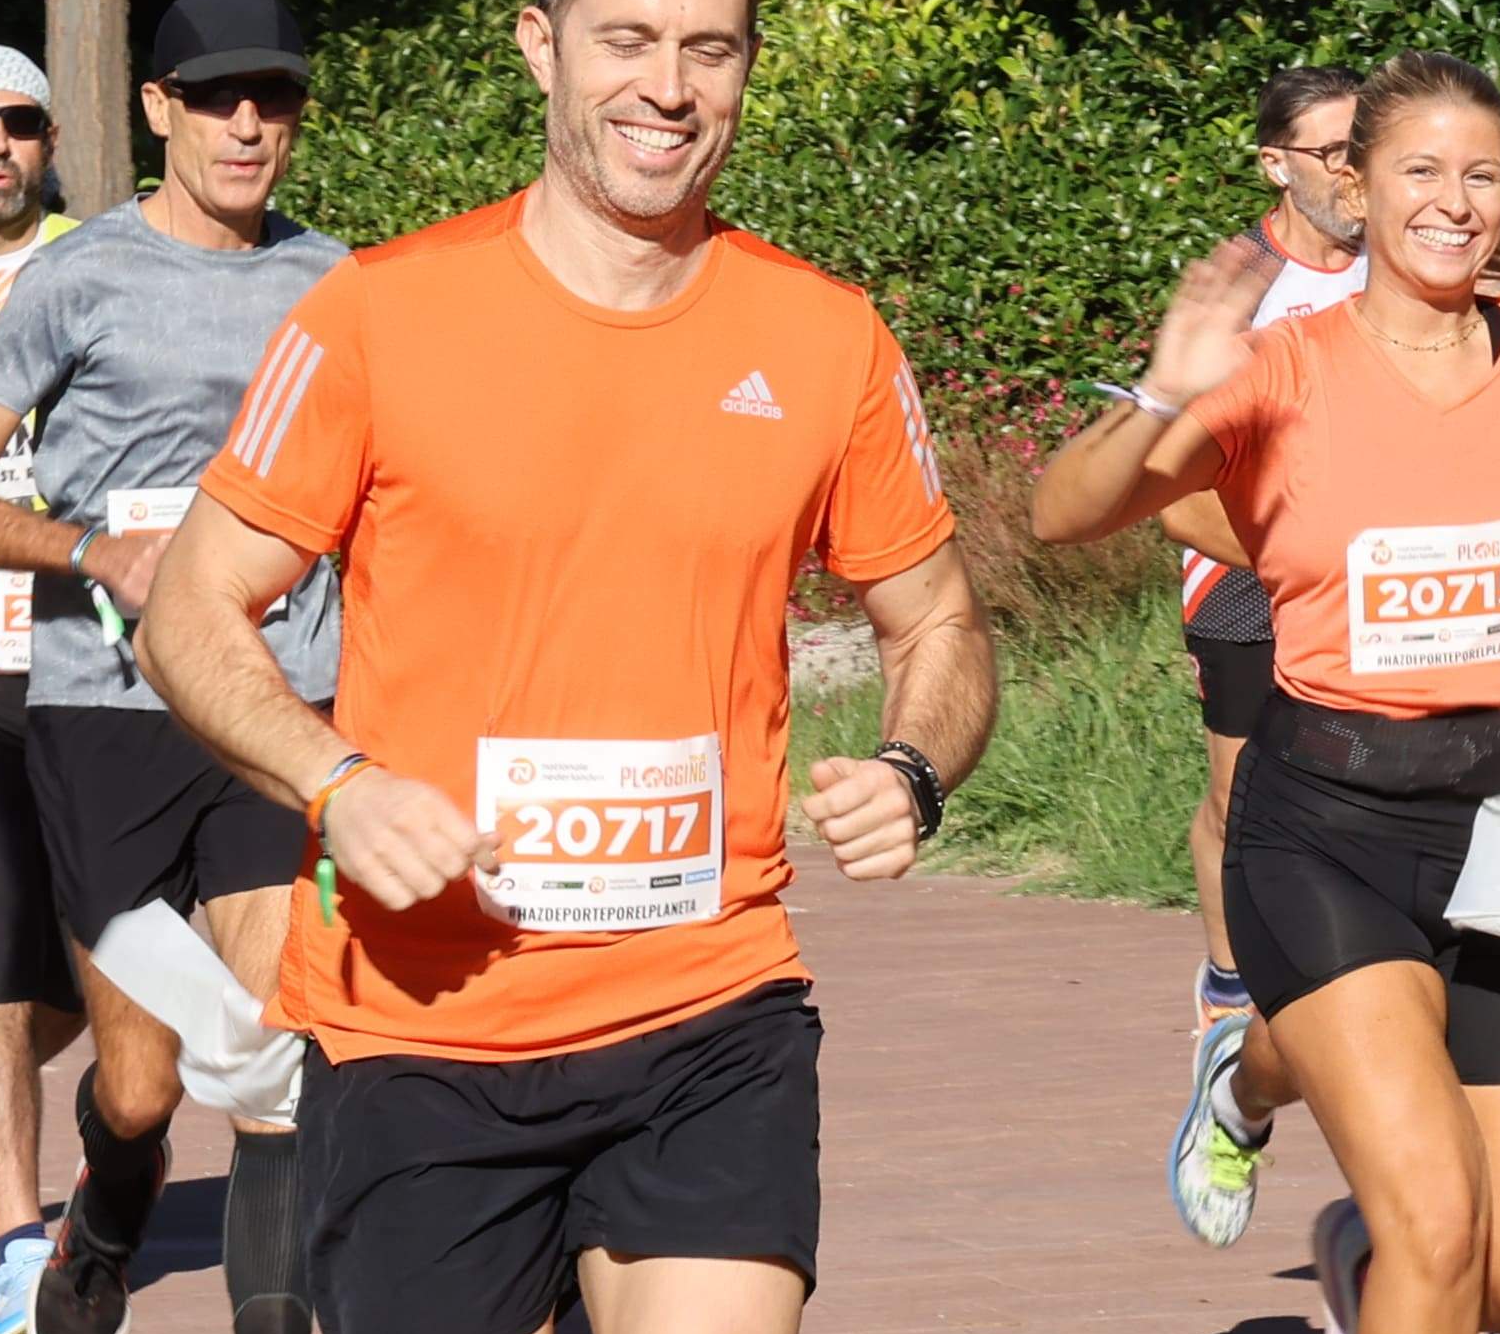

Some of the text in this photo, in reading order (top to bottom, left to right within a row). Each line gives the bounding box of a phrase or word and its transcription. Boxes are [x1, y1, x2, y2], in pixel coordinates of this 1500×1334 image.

[721, 398, 783, 419] adidas
[512, 802, 700, 856] 20717
[508, 899, 696, 923] #HAZDEPORTEPORELPLANETA
